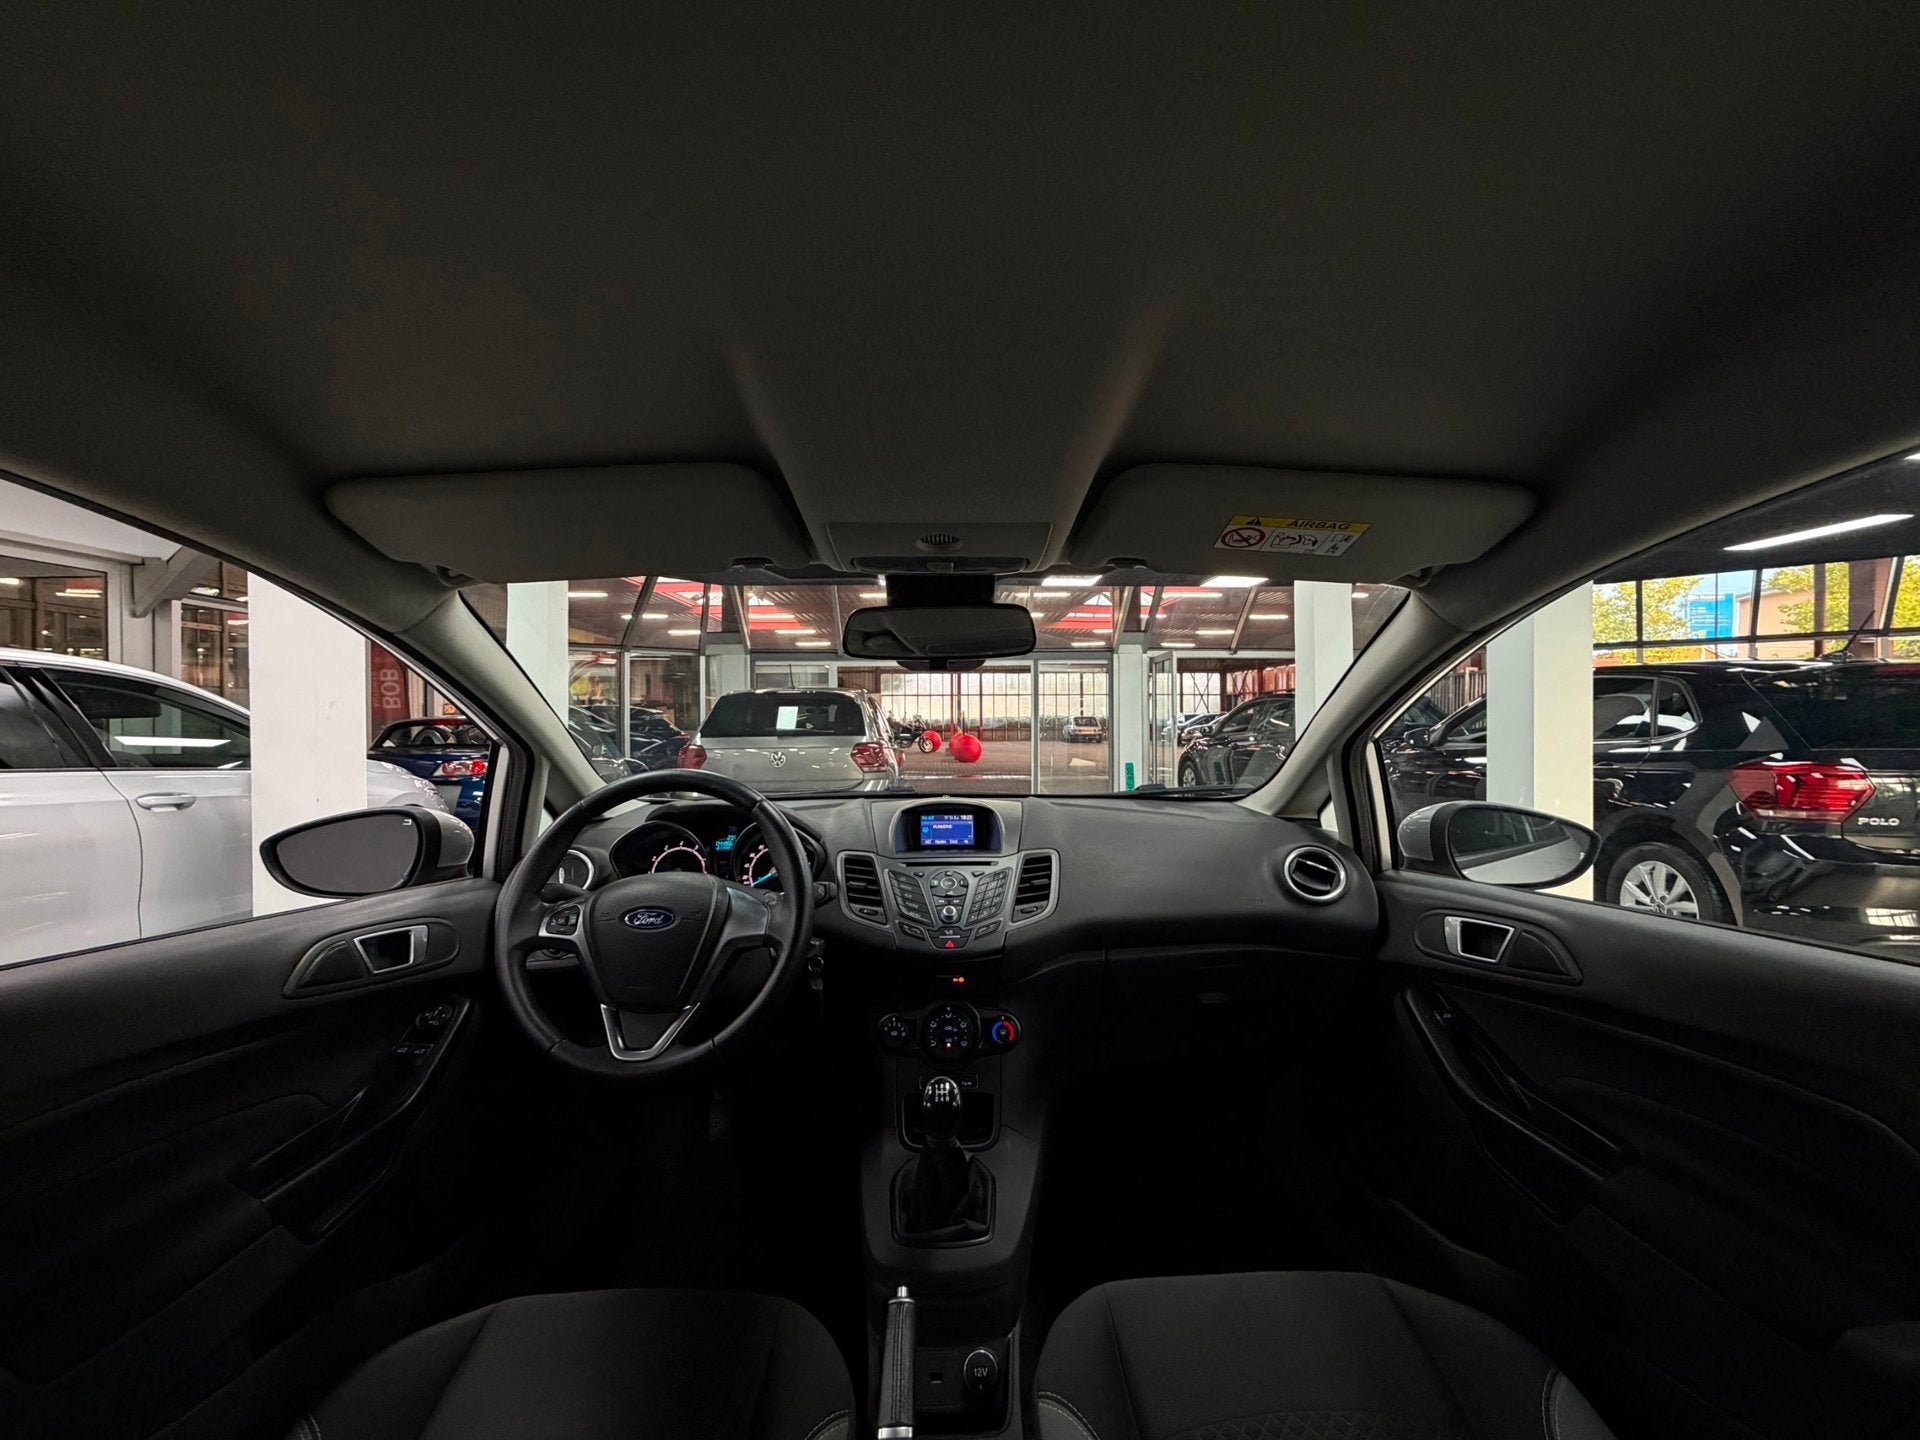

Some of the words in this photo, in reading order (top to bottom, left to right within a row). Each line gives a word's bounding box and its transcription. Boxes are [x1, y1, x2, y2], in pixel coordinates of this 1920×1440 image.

[1287, 520, 1351, 530] AIRBAG
[380, 668, 402, 709] BOB
[1857, 817, 1900, 826] POLO
[634, 911, 664, 925] Ford
[974, 1367, 988, 1377] 12V
